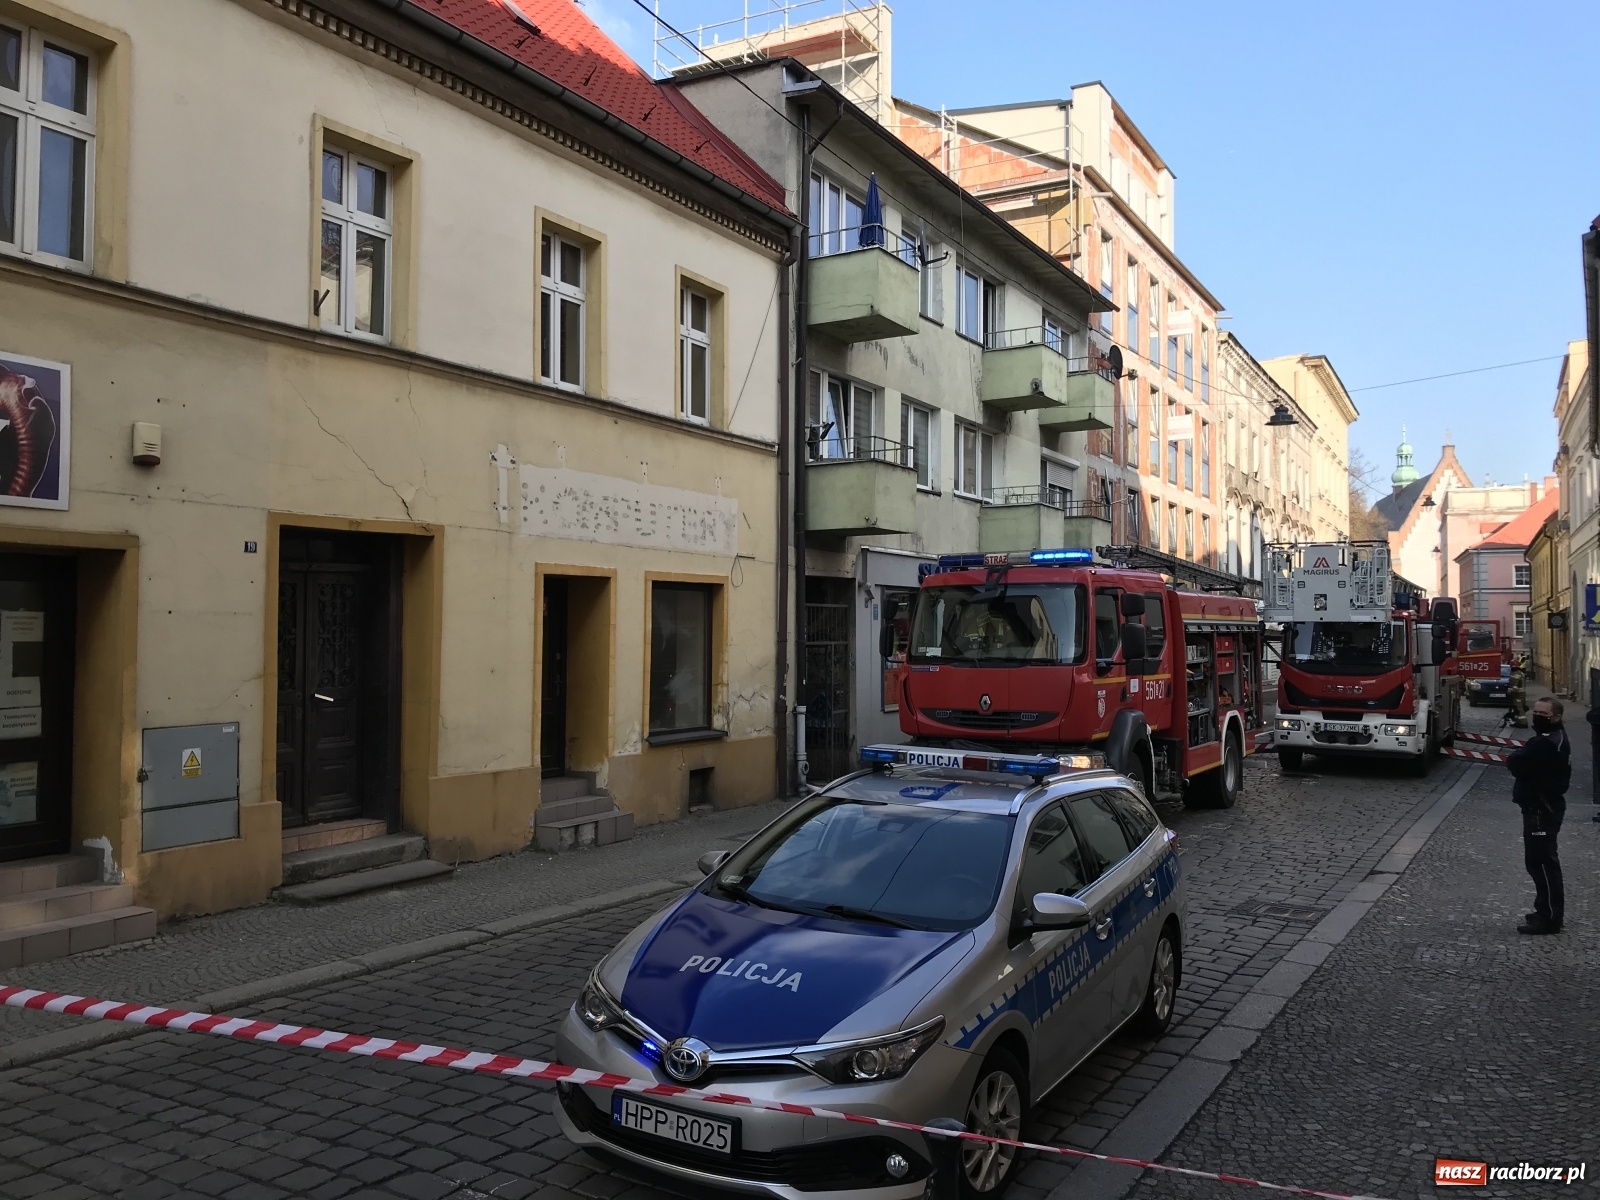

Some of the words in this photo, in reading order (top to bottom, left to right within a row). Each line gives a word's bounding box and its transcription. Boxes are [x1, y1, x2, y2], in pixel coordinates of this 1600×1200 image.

[247, 541, 256, 552] 19
[908, 753, 960, 768] POLICJA
[679, 955, 803, 993] POLICJA
[1048, 940, 1091, 999] POLICJA
[613, 1113, 621, 1121] PL
[624, 1101, 668, 1133] HPP
[675, 1114, 728, 1150] R025
